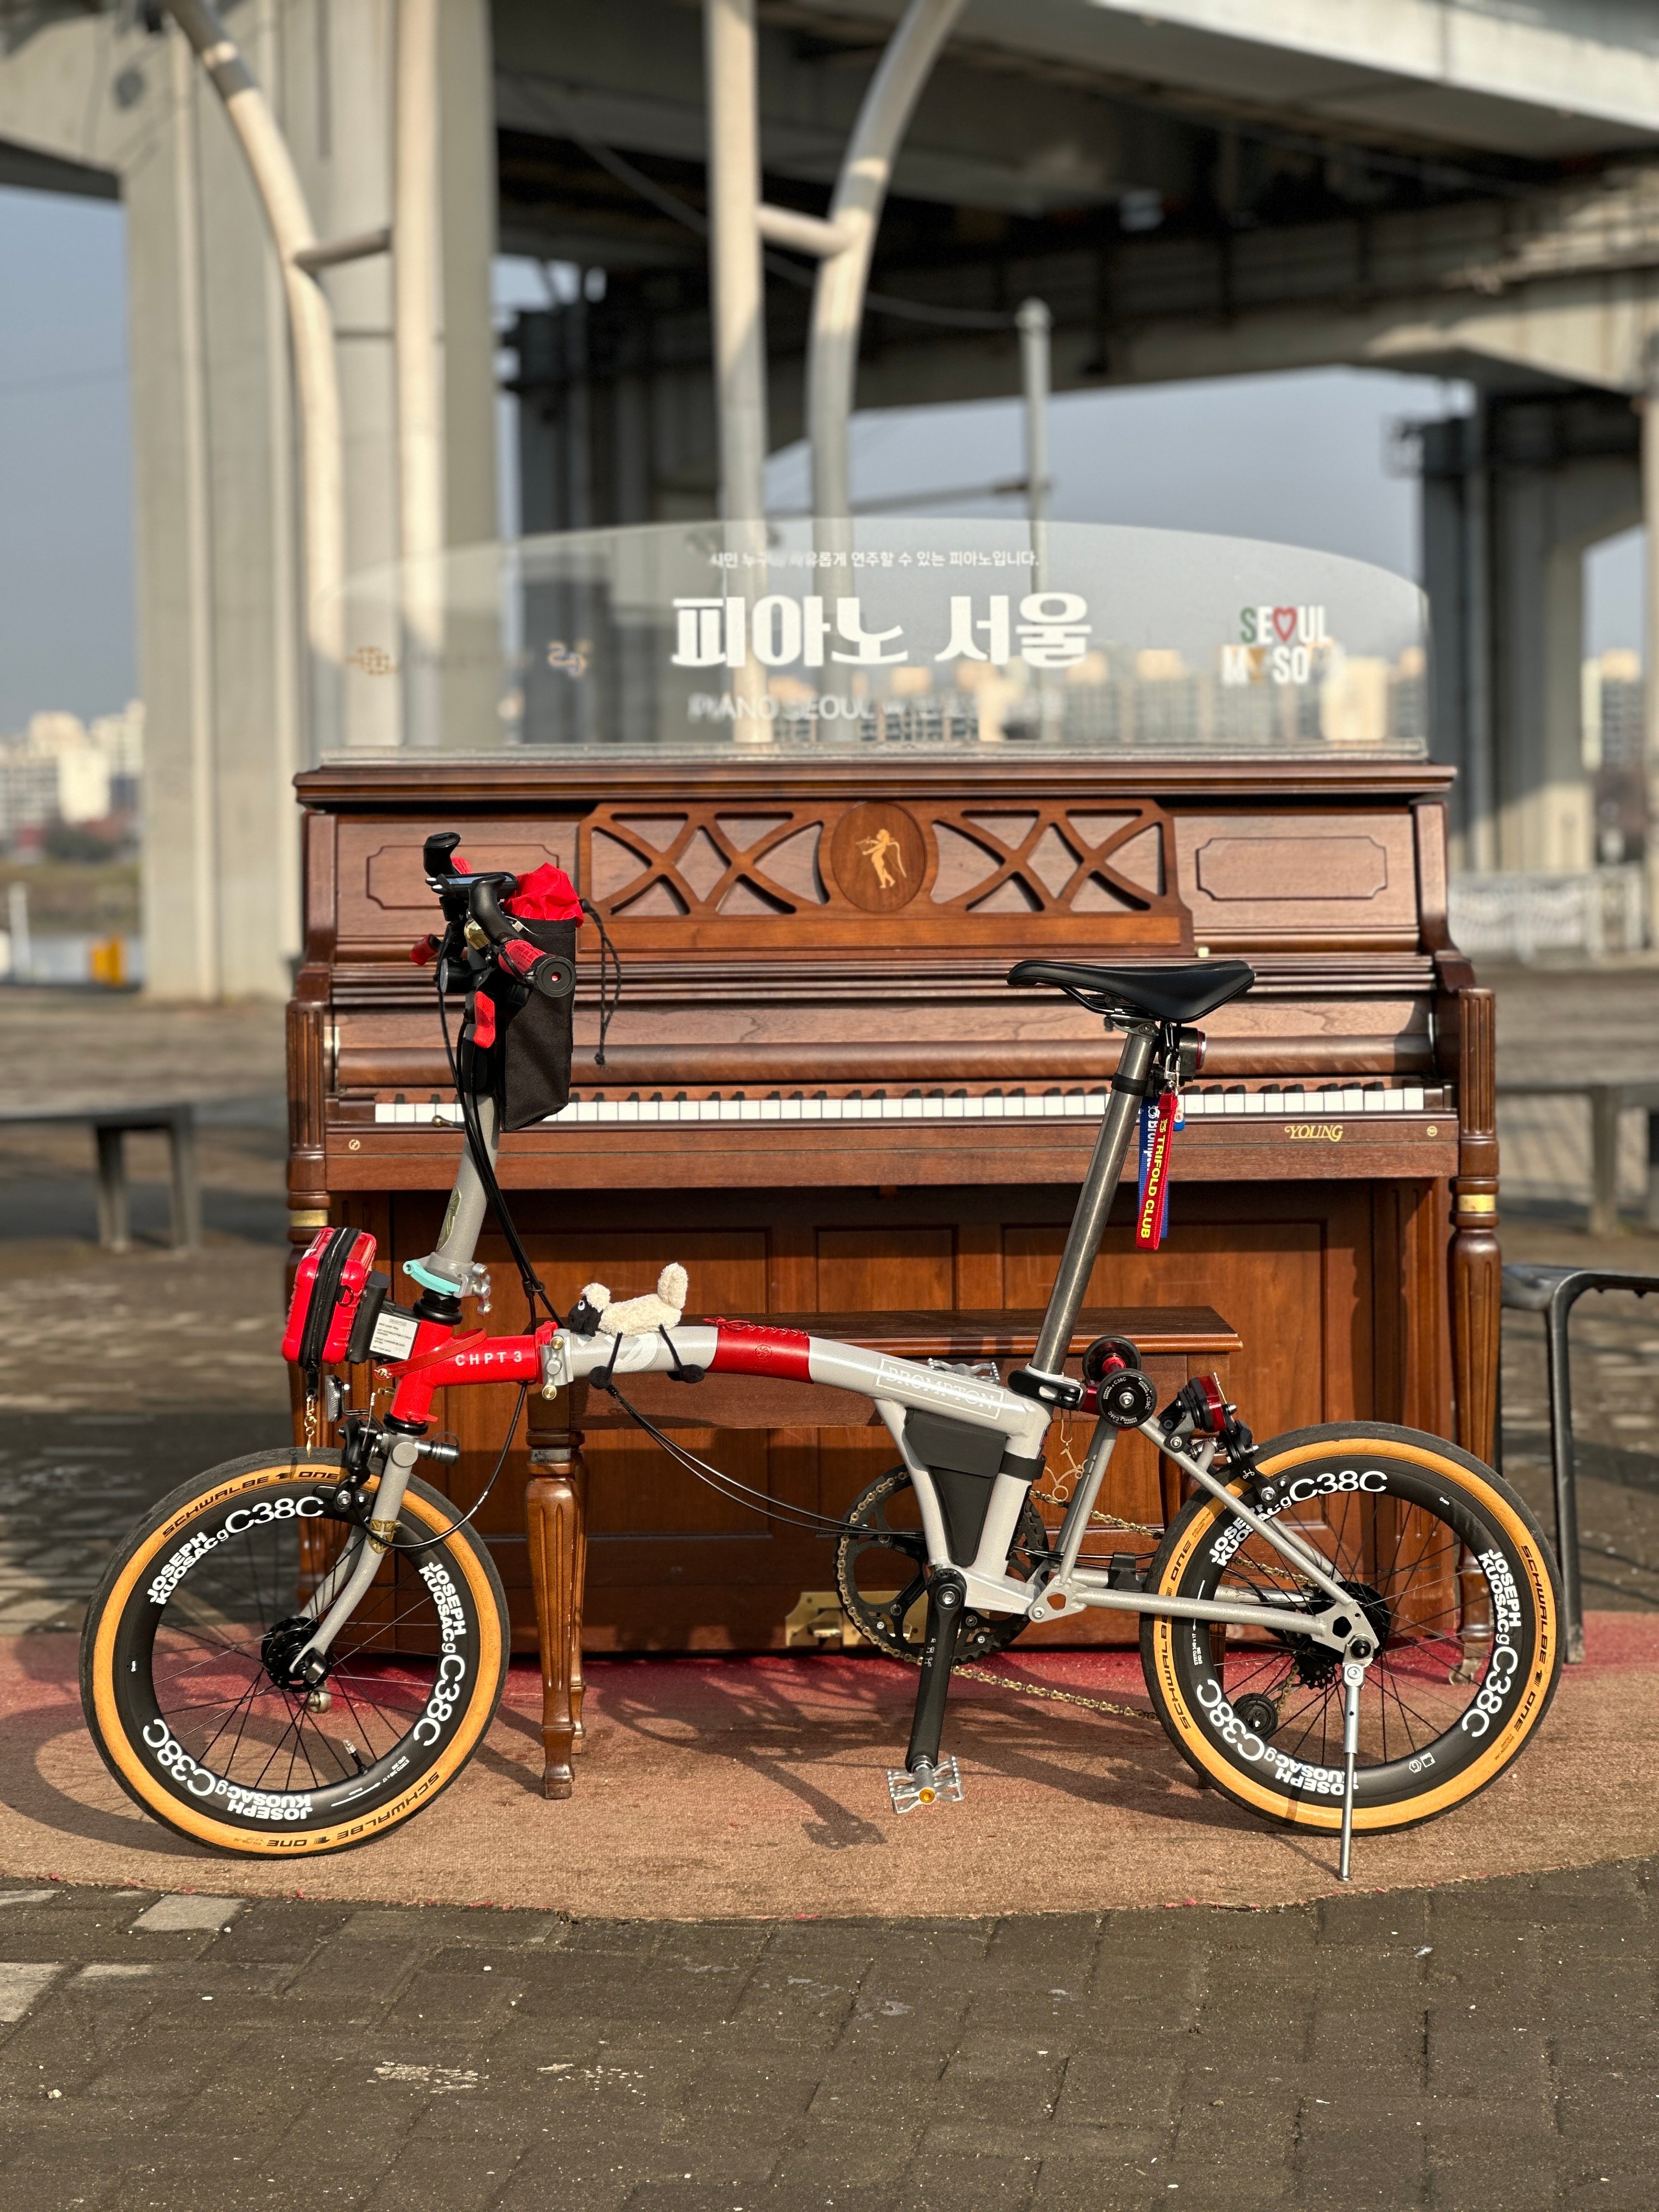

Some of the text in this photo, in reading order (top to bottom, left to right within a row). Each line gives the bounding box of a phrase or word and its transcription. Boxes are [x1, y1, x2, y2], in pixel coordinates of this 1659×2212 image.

[851, 551, 894, 567] 연주할
[899, 551, 913, 567] 수
[917, 551, 945, 567] 있는
[950, 551, 1039, 567] 피아노입니다.
[672, 591, 1092, 668] 피아노 서울
[1284, 1125, 1344, 1142] YOUNG
[1141, 1135, 1166, 1239] TRIFOLD CLUB
[455, 1350, 522, 1367] CHPT 3
[885, 1366, 996, 1409] BROMPTON
[162, 1475, 269, 1538] SCHWALBE
[298, 1471, 340, 1480] ONE
[225, 1496, 324, 1534] C38C
[1289, 1470, 1388, 1502] C38C
[146, 1531, 209, 1604] JOSEPH
[1170, 1540, 1192, 1582] ONE
[1488, 1549, 1521, 1627] JOSEPH
[428, 1561, 466, 1636] JOSEPH
[1521, 1545, 1548, 1664] SCHWALBE
[413, 1654, 466, 1747] C38C
[1197, 1679, 1265, 1761] C38C
[1462, 1646, 1518, 1737] C38C
[1514, 1691, 1536, 1732] ONE
[143, 1719, 216, 1796] C38C
[227, 1799, 313, 1820] JOSEPH
[336, 1771, 439, 1840] SCHWALBE
[266, 1839, 308, 1847] ONE
